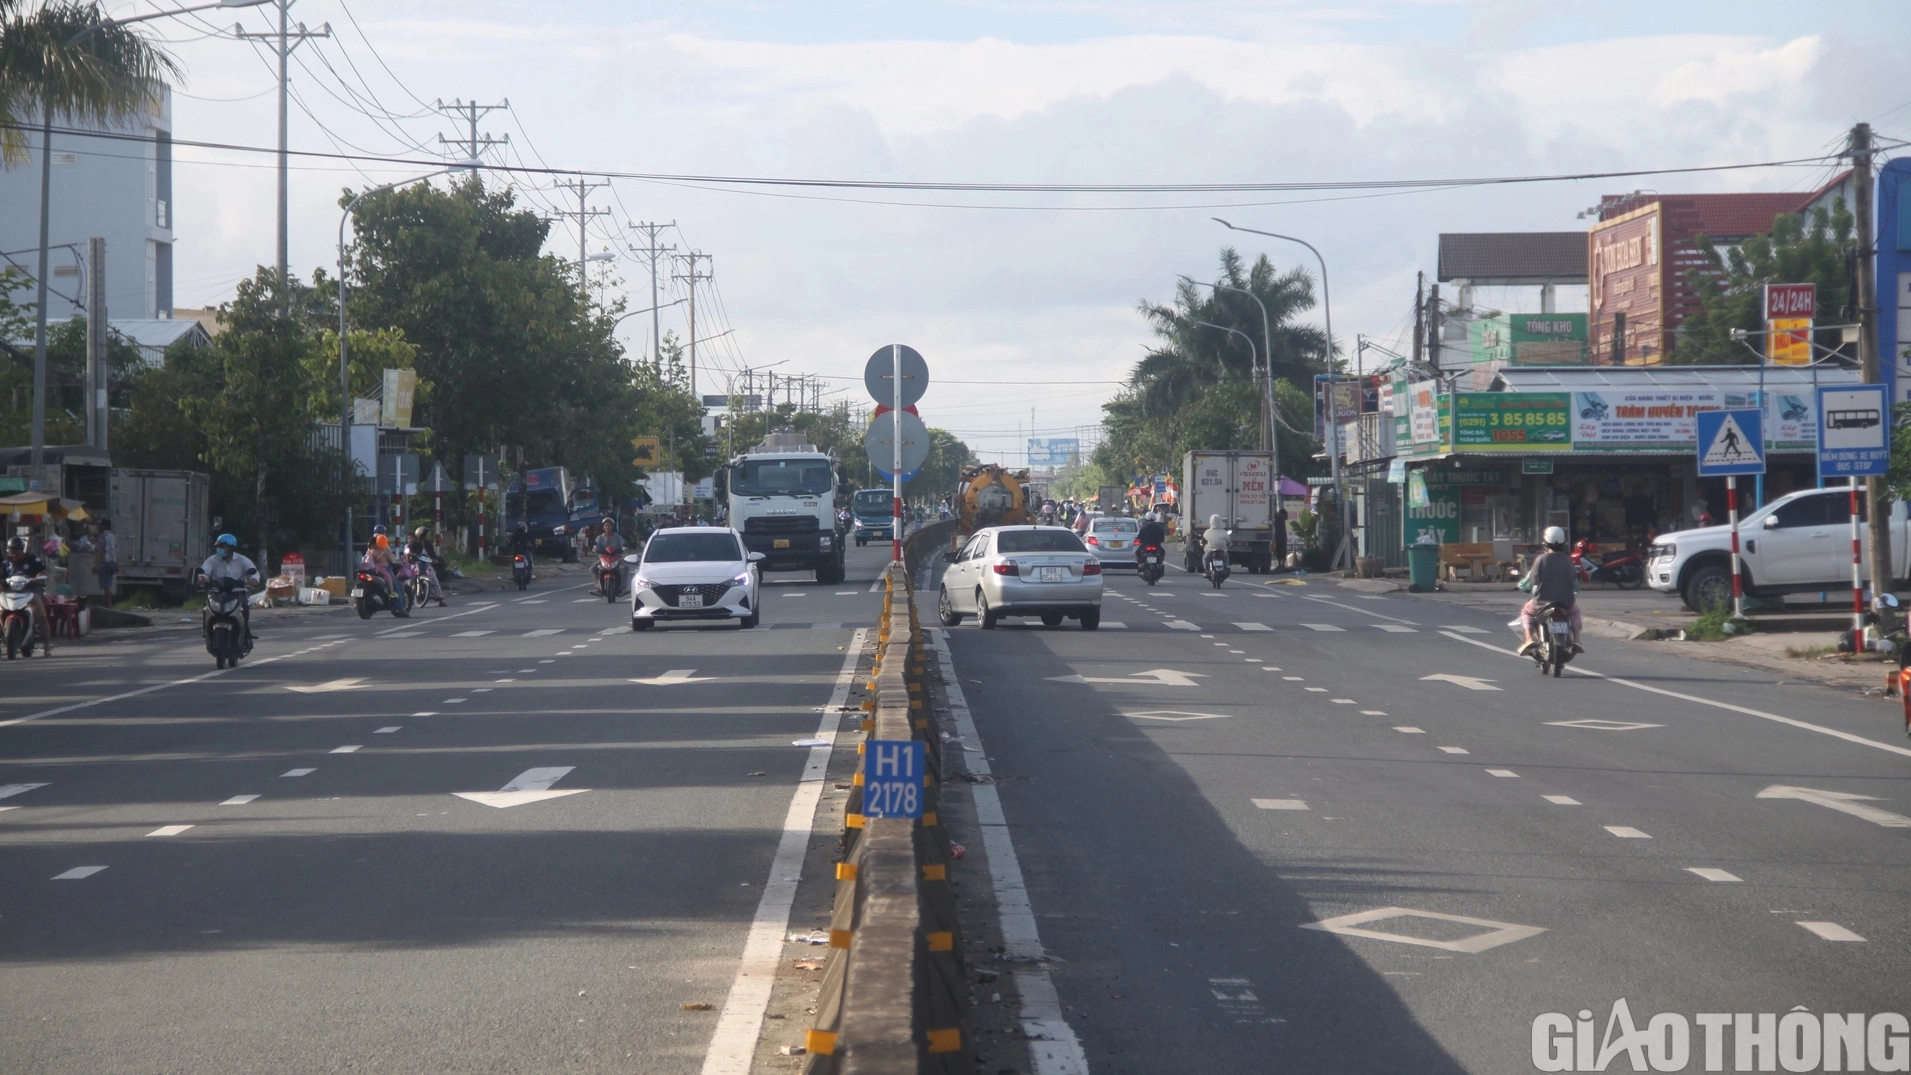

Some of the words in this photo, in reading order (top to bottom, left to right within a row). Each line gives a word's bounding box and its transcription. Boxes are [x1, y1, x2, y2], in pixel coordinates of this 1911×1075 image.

[1772, 289, 1811, 314] 24/24H
[1554, 320, 1572, 333] KHO
[1328, 410, 1357, 418] SIGON
[1459, 418, 1486, 427] (0291)
[1489, 412, 1499, 426] 3
[1503, 412, 1523, 426] 85
[1525, 412, 1544, 426] 85
[1546, 412, 1566, 426] 85
[1491, 429, 1527, 442] 1055
[1860, 451, 1868, 460] XE
[1837, 462, 1851, 471] BUS
[1854, 461, 1872, 470] STOP
[876, 745, 913, 777] H1
[868, 781, 917, 814] 2178
